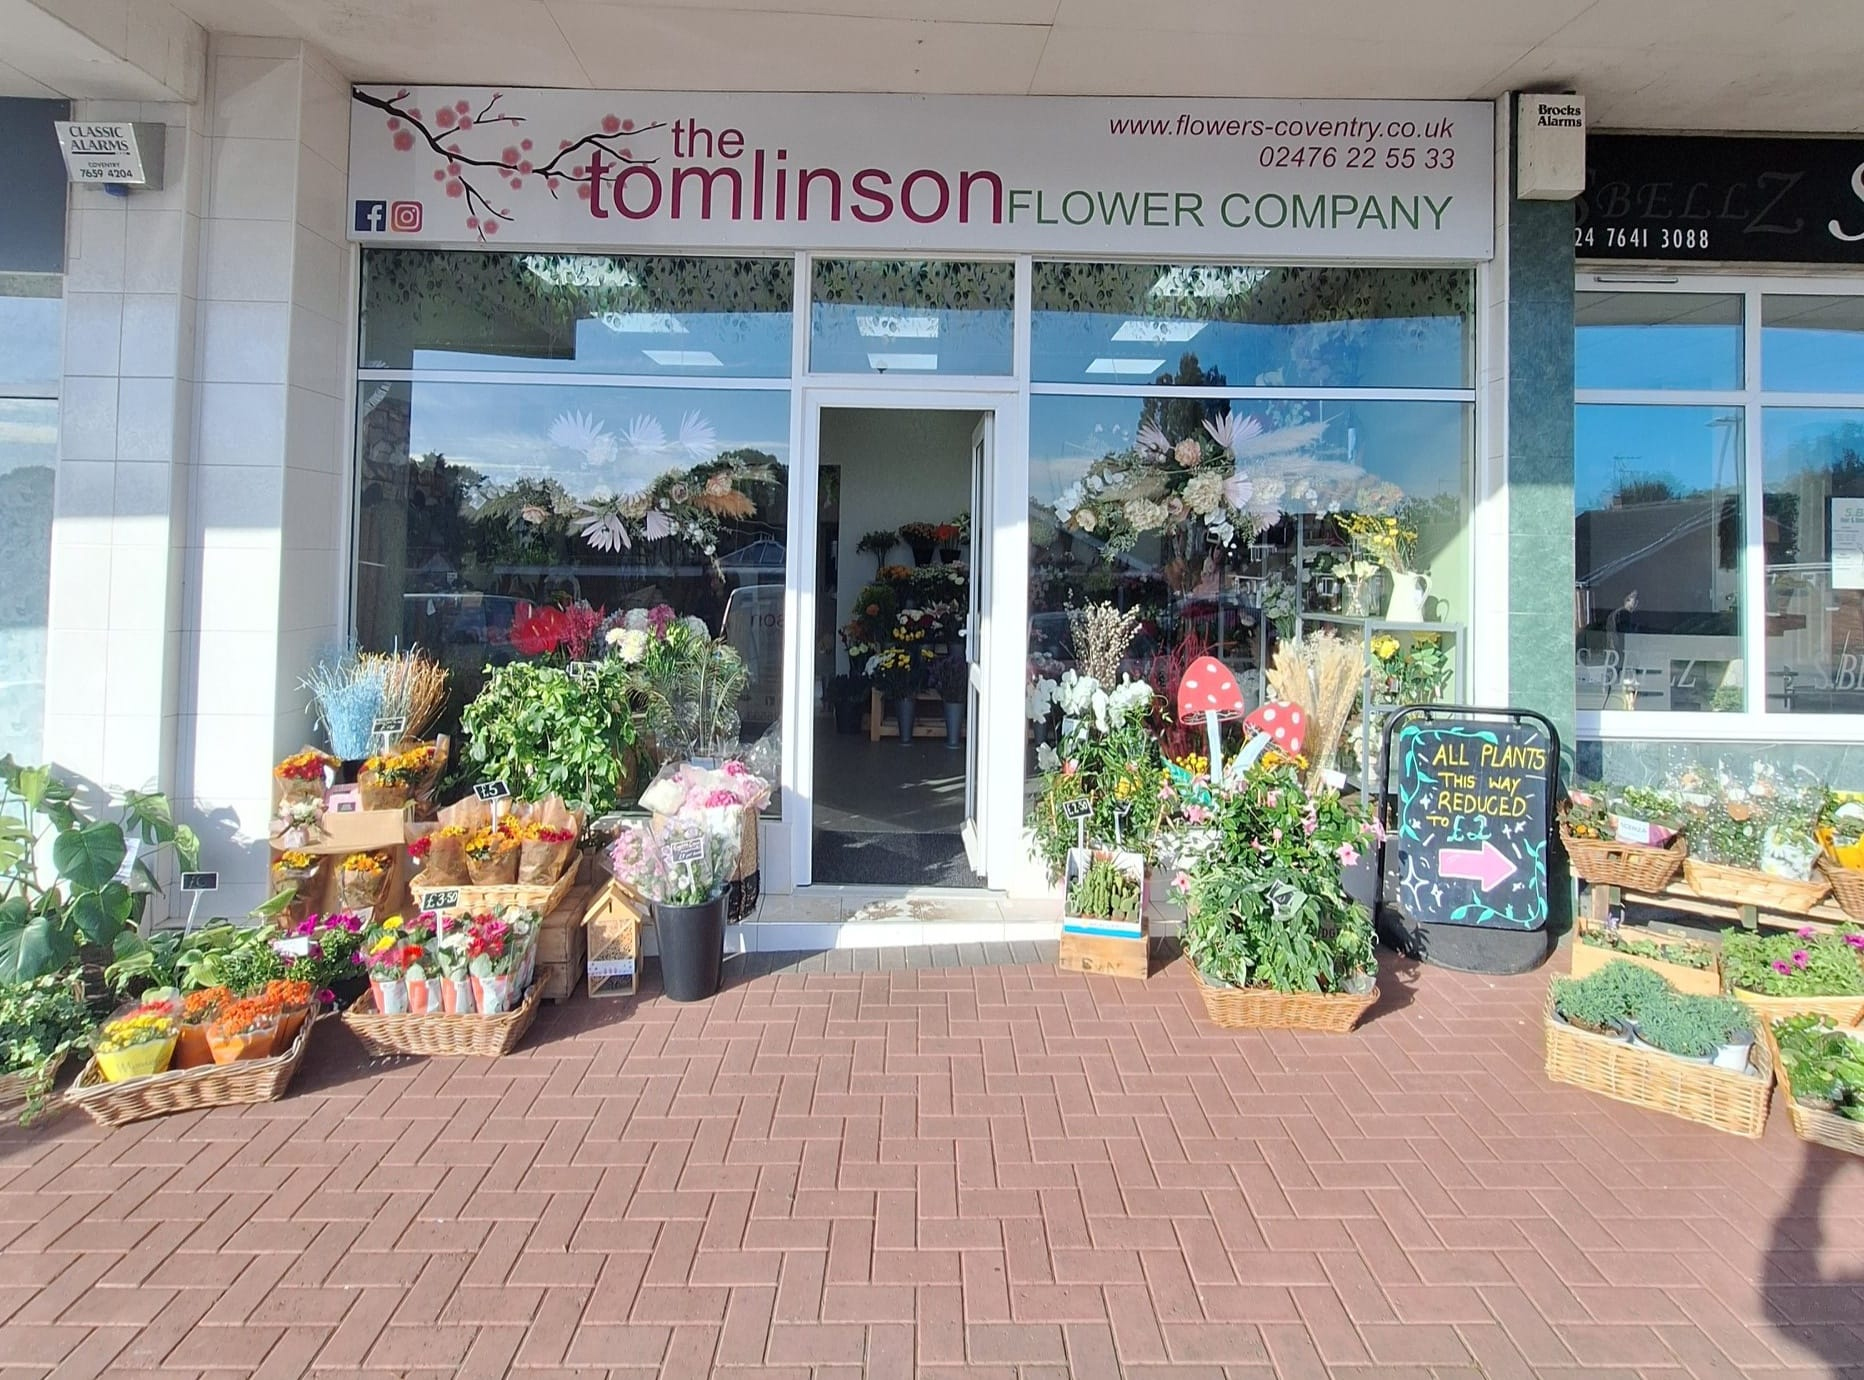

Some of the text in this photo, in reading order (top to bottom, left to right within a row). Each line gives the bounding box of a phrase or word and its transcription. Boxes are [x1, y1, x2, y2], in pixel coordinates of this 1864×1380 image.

[1537, 116, 1582, 127] Alarms
[1538, 104, 1581, 116] Brocks
[69, 126, 123, 138] CLASSIC
[671, 118, 745, 158] the
[1109, 114, 1454, 142] www.flowers-coventry.co.uk
[71, 139, 129, 151] ALARMS
[1259, 146, 1455, 169] 02476 22 55 33
[80, 169, 133, 178] 7659 4204
[585, 149, 1453, 230] tomlinson FLOWER COMPANY
[1575, 170, 1805, 233] BELLZ
[1607, 228, 1648, 248] 7641
[1661, 228, 1709, 249] 3088
[1432, 743, 1546, 770] ALL PLANTS
[481, 784, 498, 797] £5
[1438, 772, 1521, 797] THIS WAY
[1438, 791, 1526, 817] REDUCED
[1426, 814, 1491, 841] TO £2
